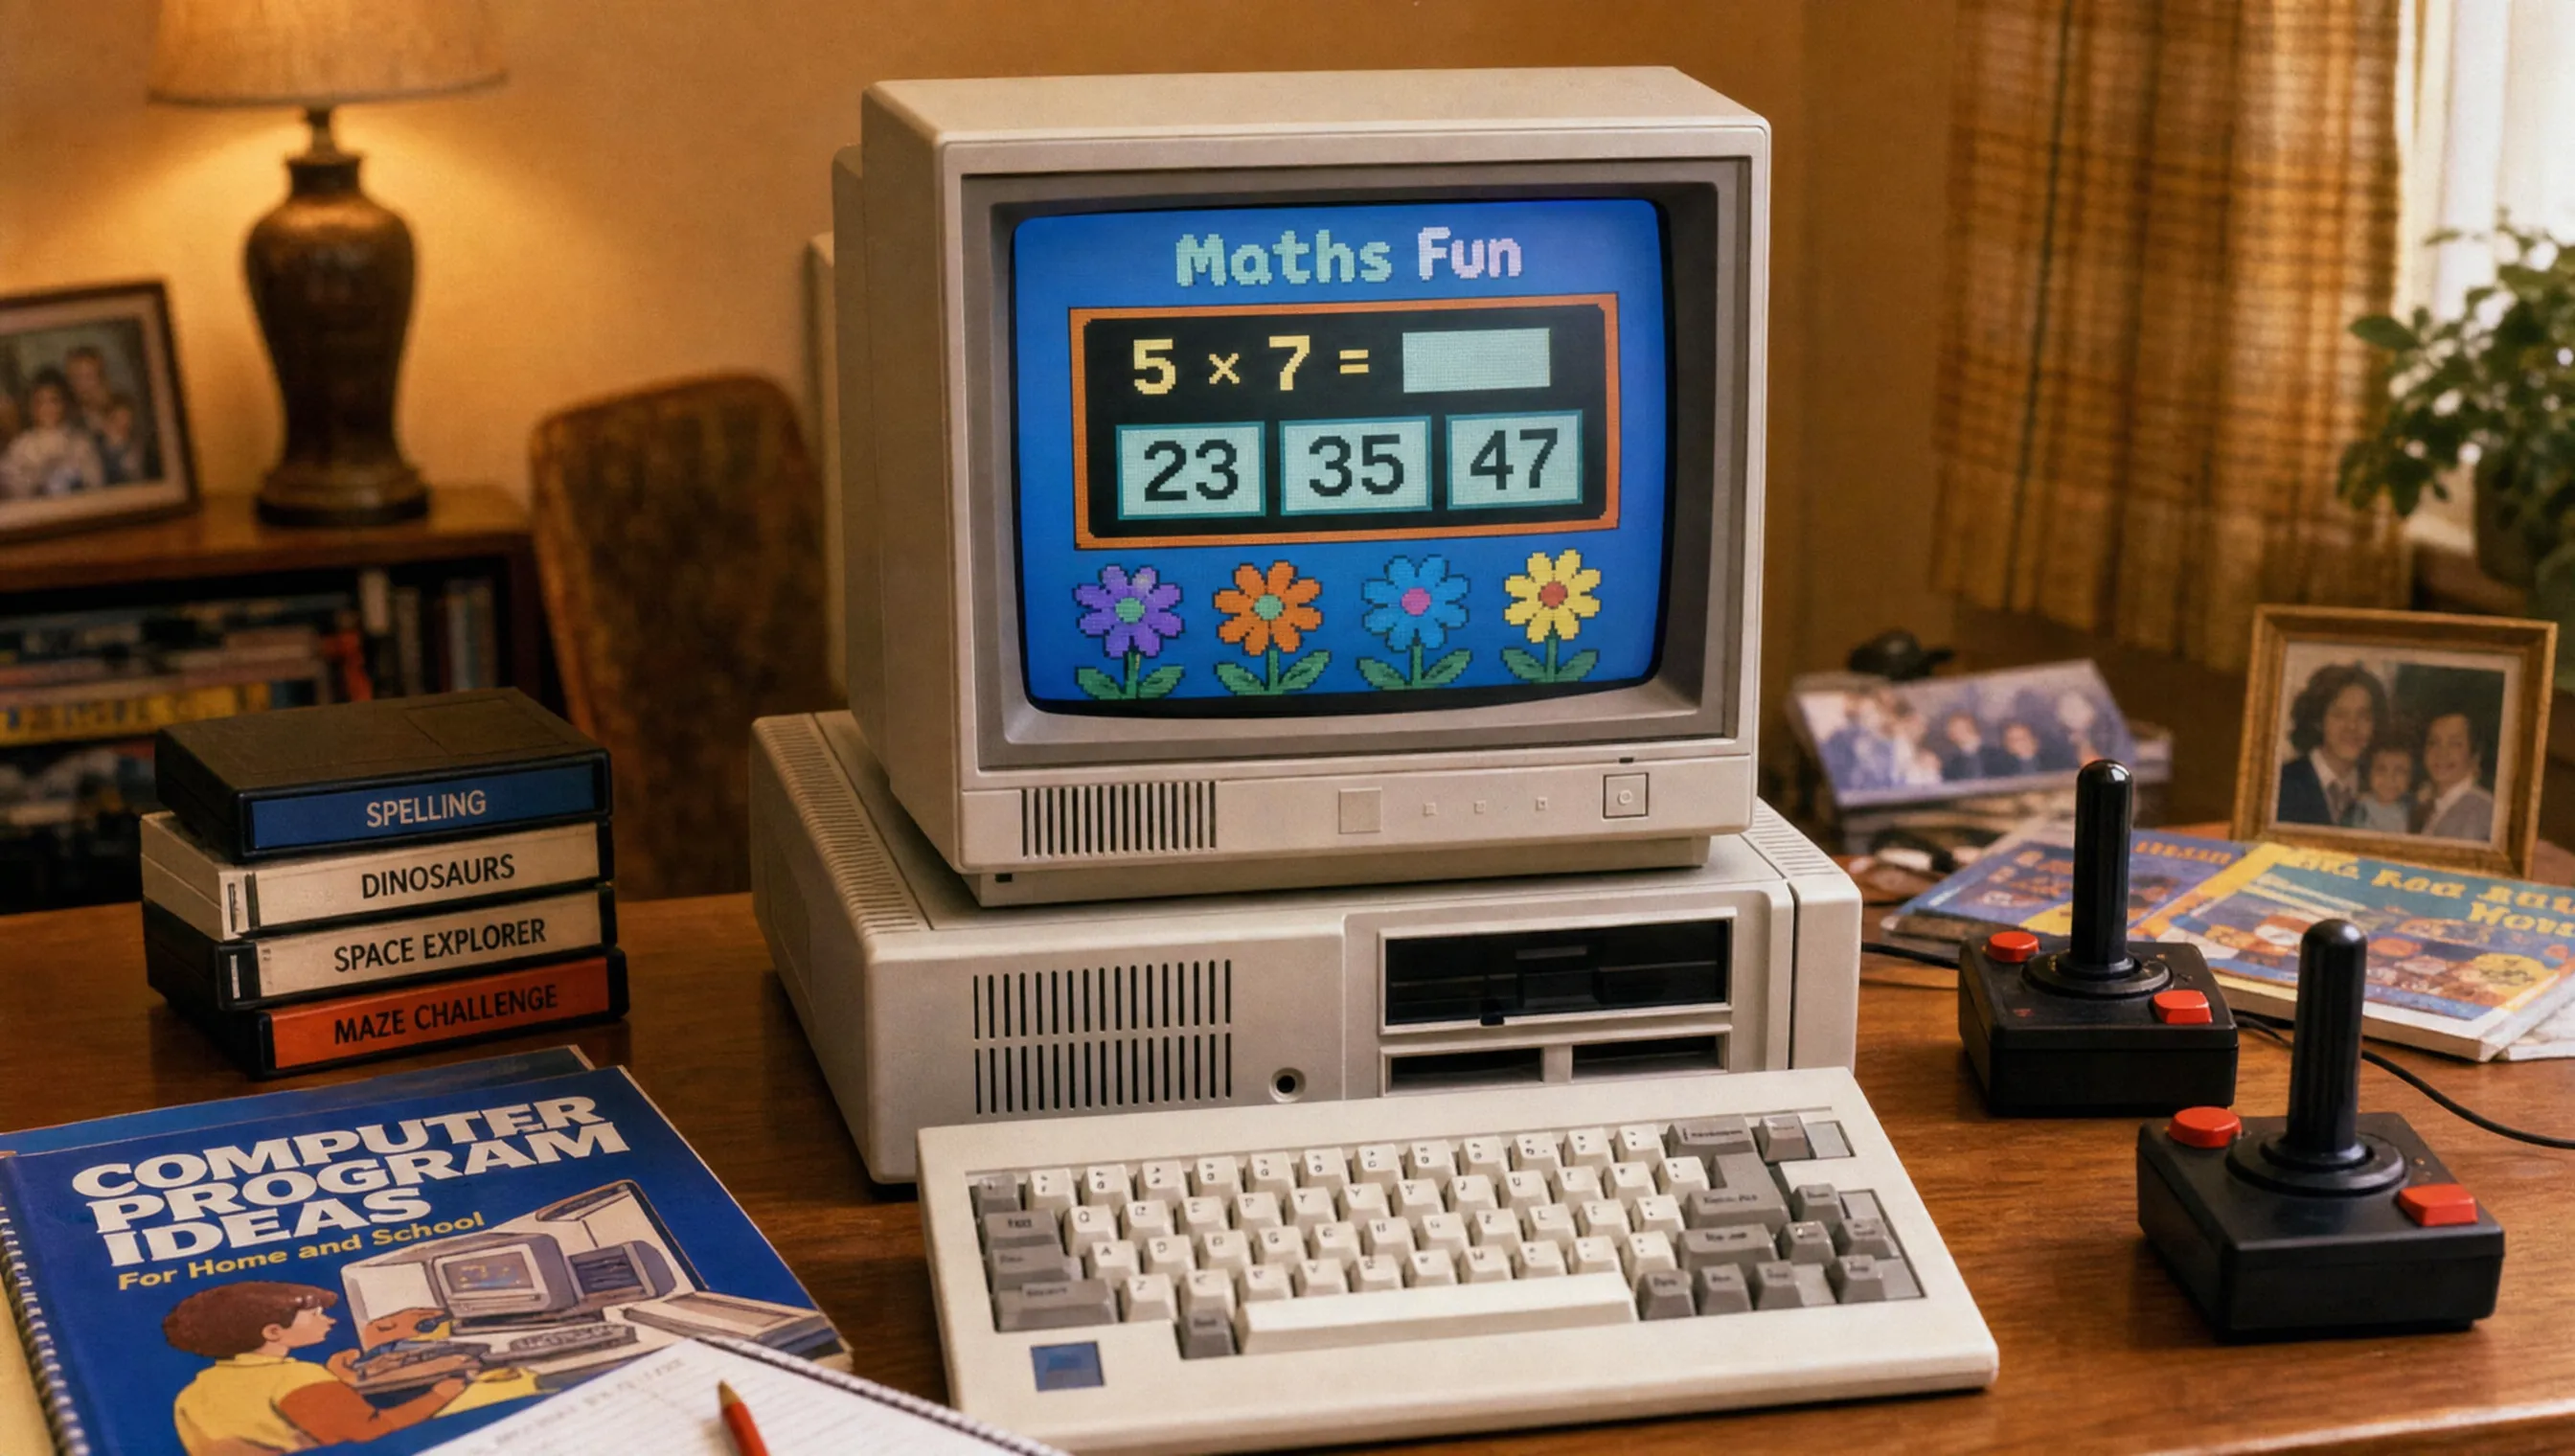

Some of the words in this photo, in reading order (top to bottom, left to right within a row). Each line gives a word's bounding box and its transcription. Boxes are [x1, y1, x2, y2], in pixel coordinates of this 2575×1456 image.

[1176, 229, 1392, 287] Maths
[1418, 226, 1522, 281] Fun
[1133, 338, 1176, 395] 5
[1268, 335, 1310, 391] 7
[1144, 439, 1239, 502] 23
[1309, 434, 1404, 497] 35
[1470, 427, 1559, 490] 47
[366, 789, 487, 829] SPELLING
[361, 853, 515, 899] DINOSAURS
[334, 936, 415, 973] SPACE
[423, 919, 547, 960] EXPLORER
[334, 1009, 407, 1045] MAZE
[414, 985, 558, 1031] CHALLENGE
[71, 1096, 606, 1198] COMPUTER
[86, 1121, 630, 1234] PROGRAM
[102, 1187, 432, 1267] IDEAS
[118, 1266, 178, 1291] For
[188, 1250, 288, 1278] Home
[298, 1234, 362, 1259] and
[371, 1211, 485, 1246] School
